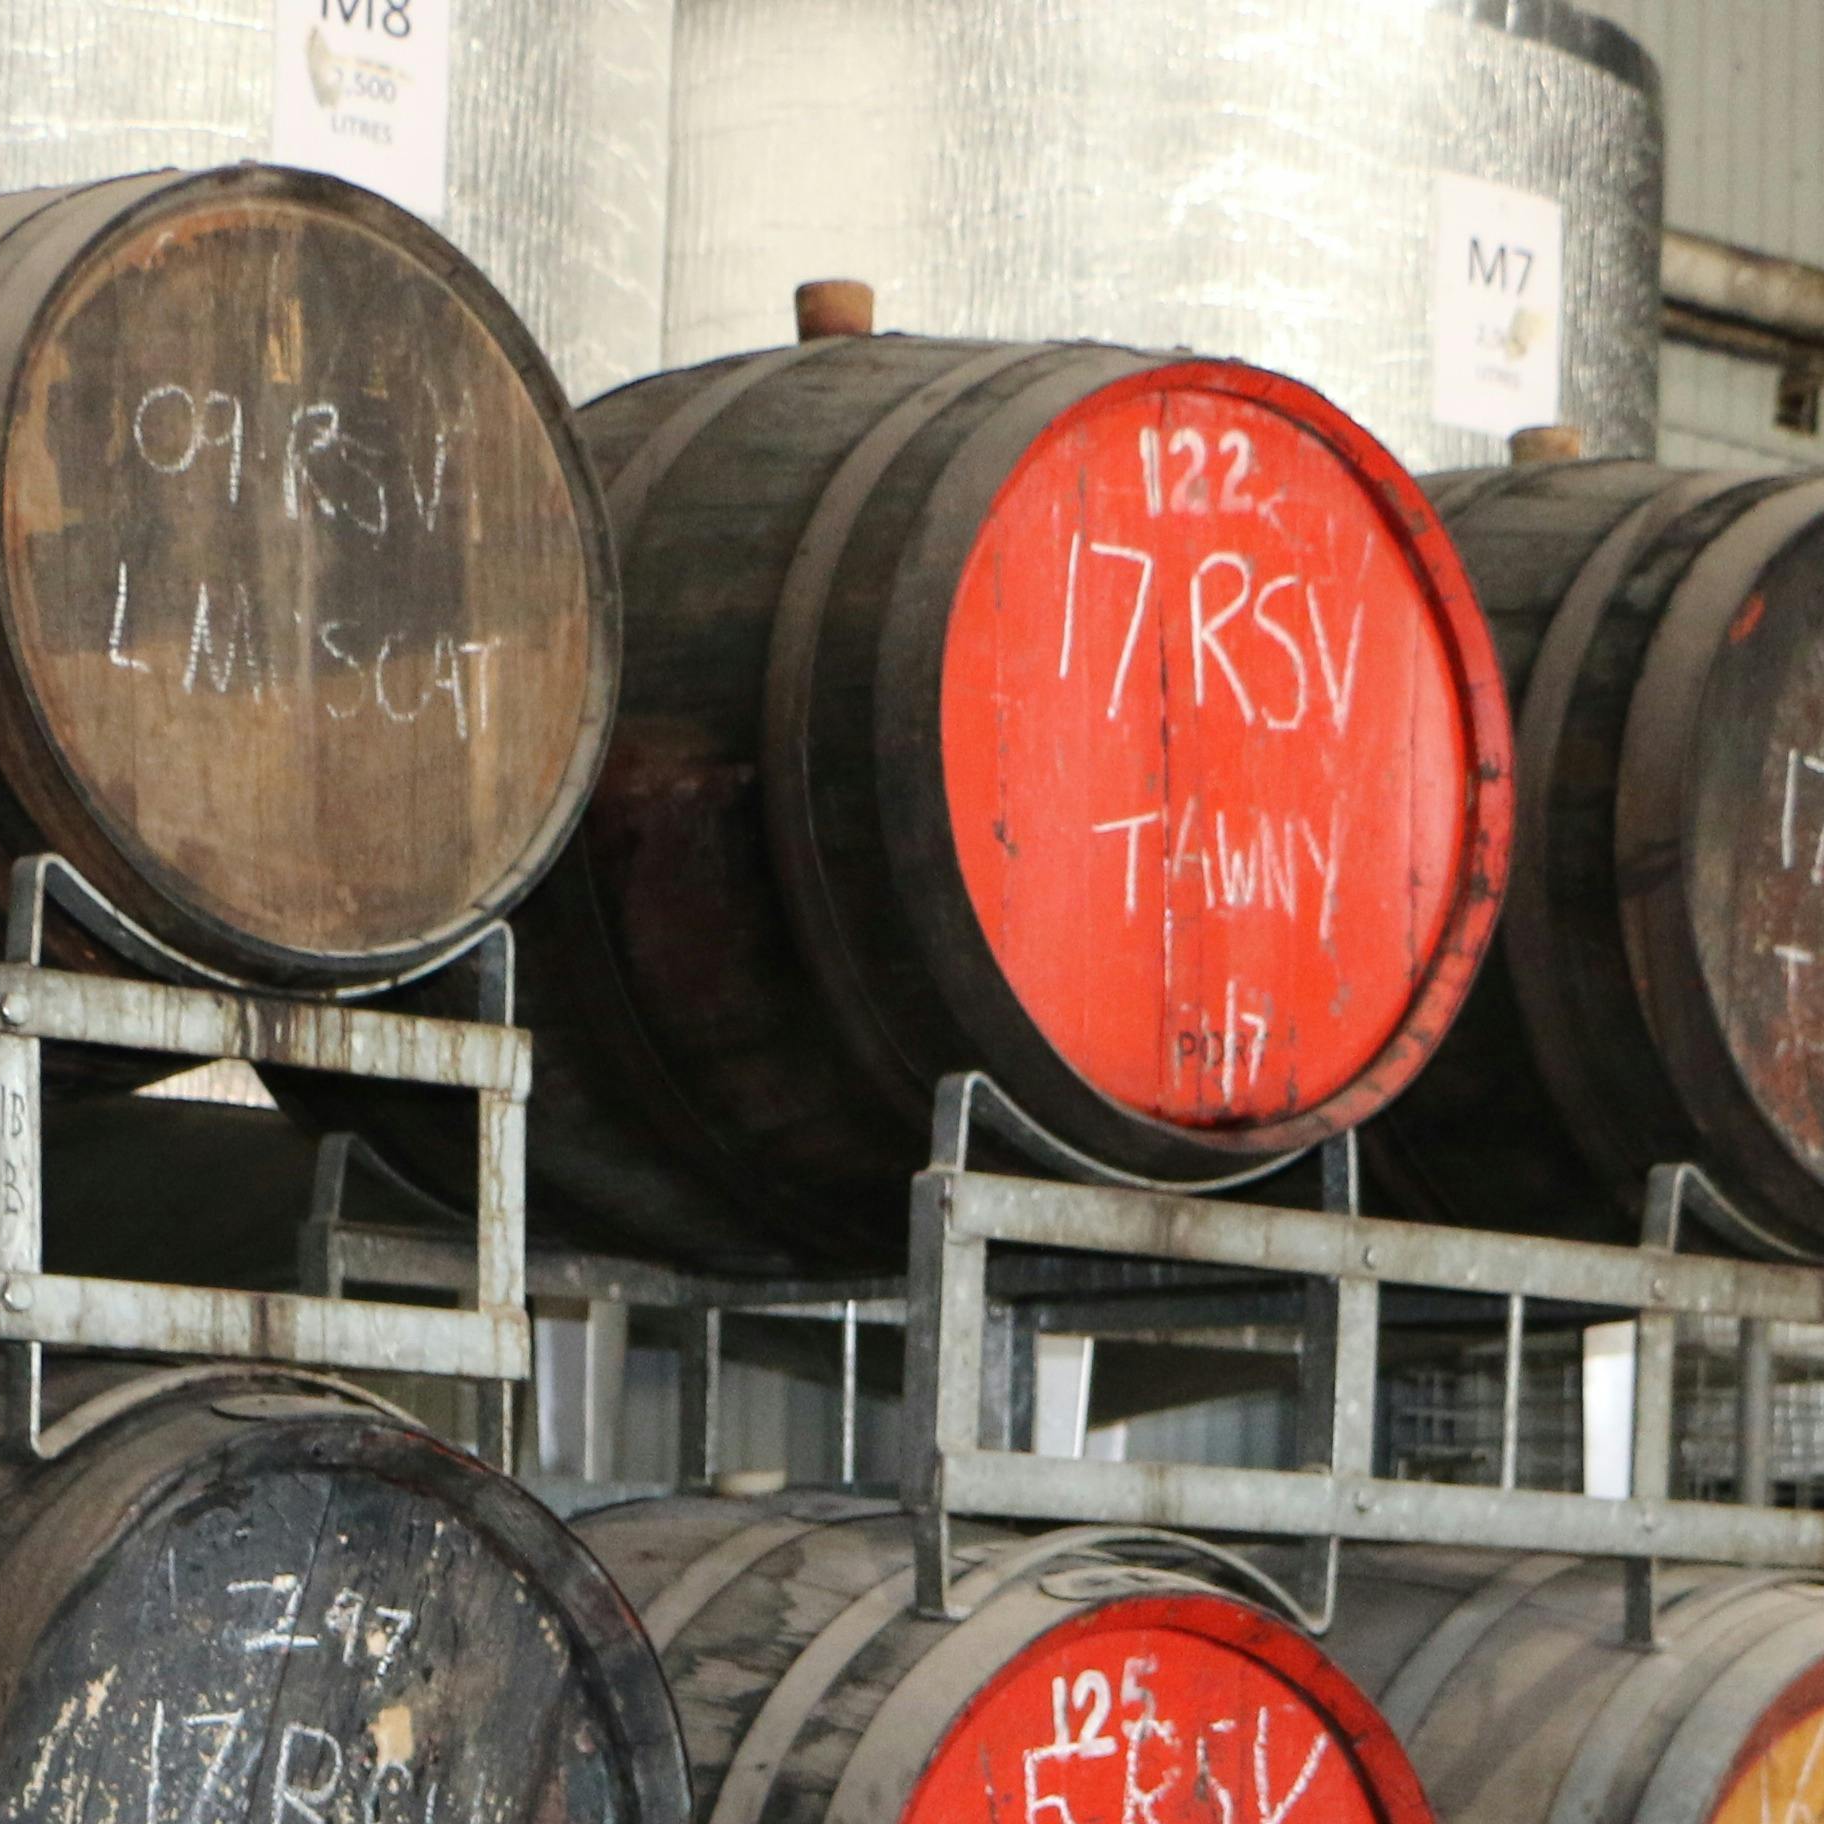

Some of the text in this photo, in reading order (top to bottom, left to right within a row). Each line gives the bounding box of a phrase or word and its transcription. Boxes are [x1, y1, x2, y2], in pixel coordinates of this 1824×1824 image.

[1467, 236, 1535, 296] M7
[1139, 427, 1256, 519] 122
[1058, 530, 1374, 735] 17 RSV
[1090, 788, 1349, 943] TAWNY
